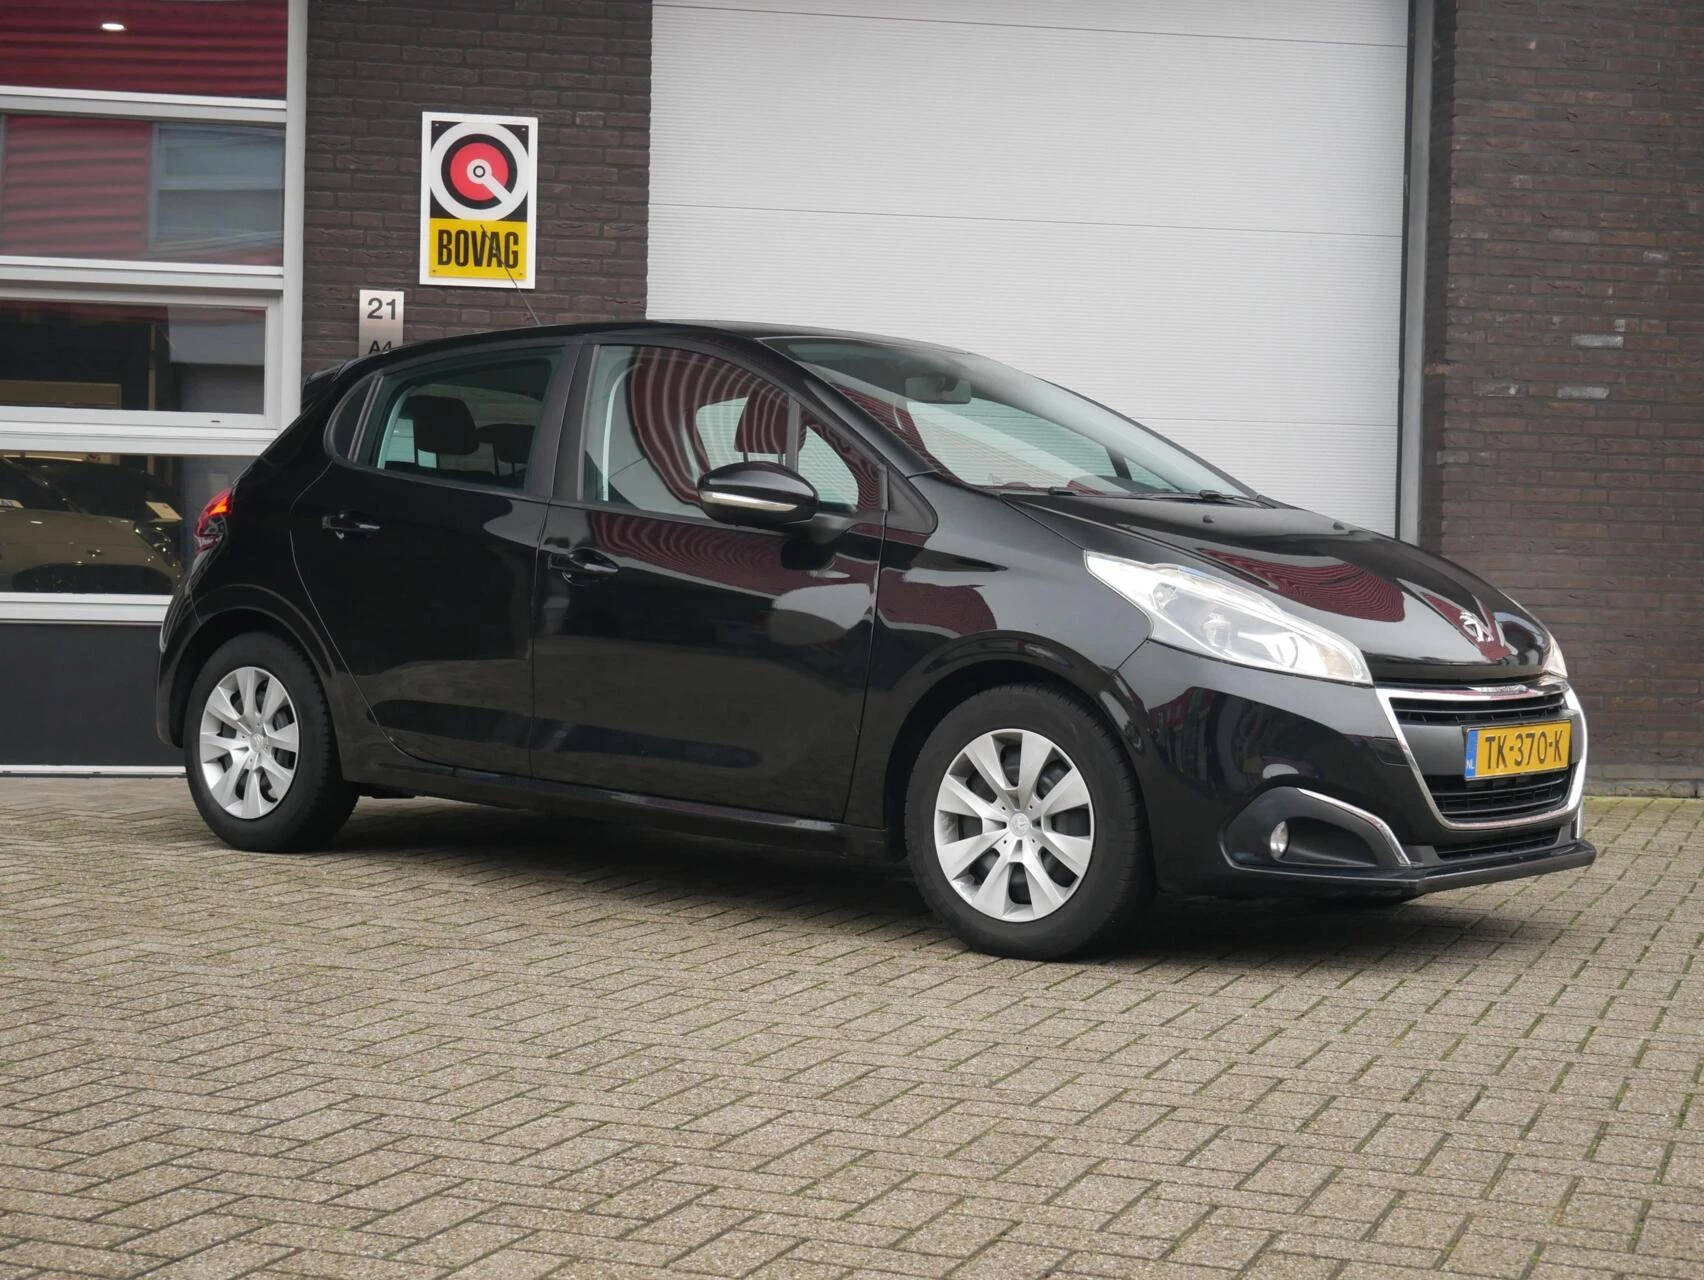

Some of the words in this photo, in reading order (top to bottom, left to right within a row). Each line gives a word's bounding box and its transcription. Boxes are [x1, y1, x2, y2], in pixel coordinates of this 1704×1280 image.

[437, 229, 519, 269] BOVAG
[366, 297, 397, 320] 21
[1485, 730, 1563, 769] TK-370-K
